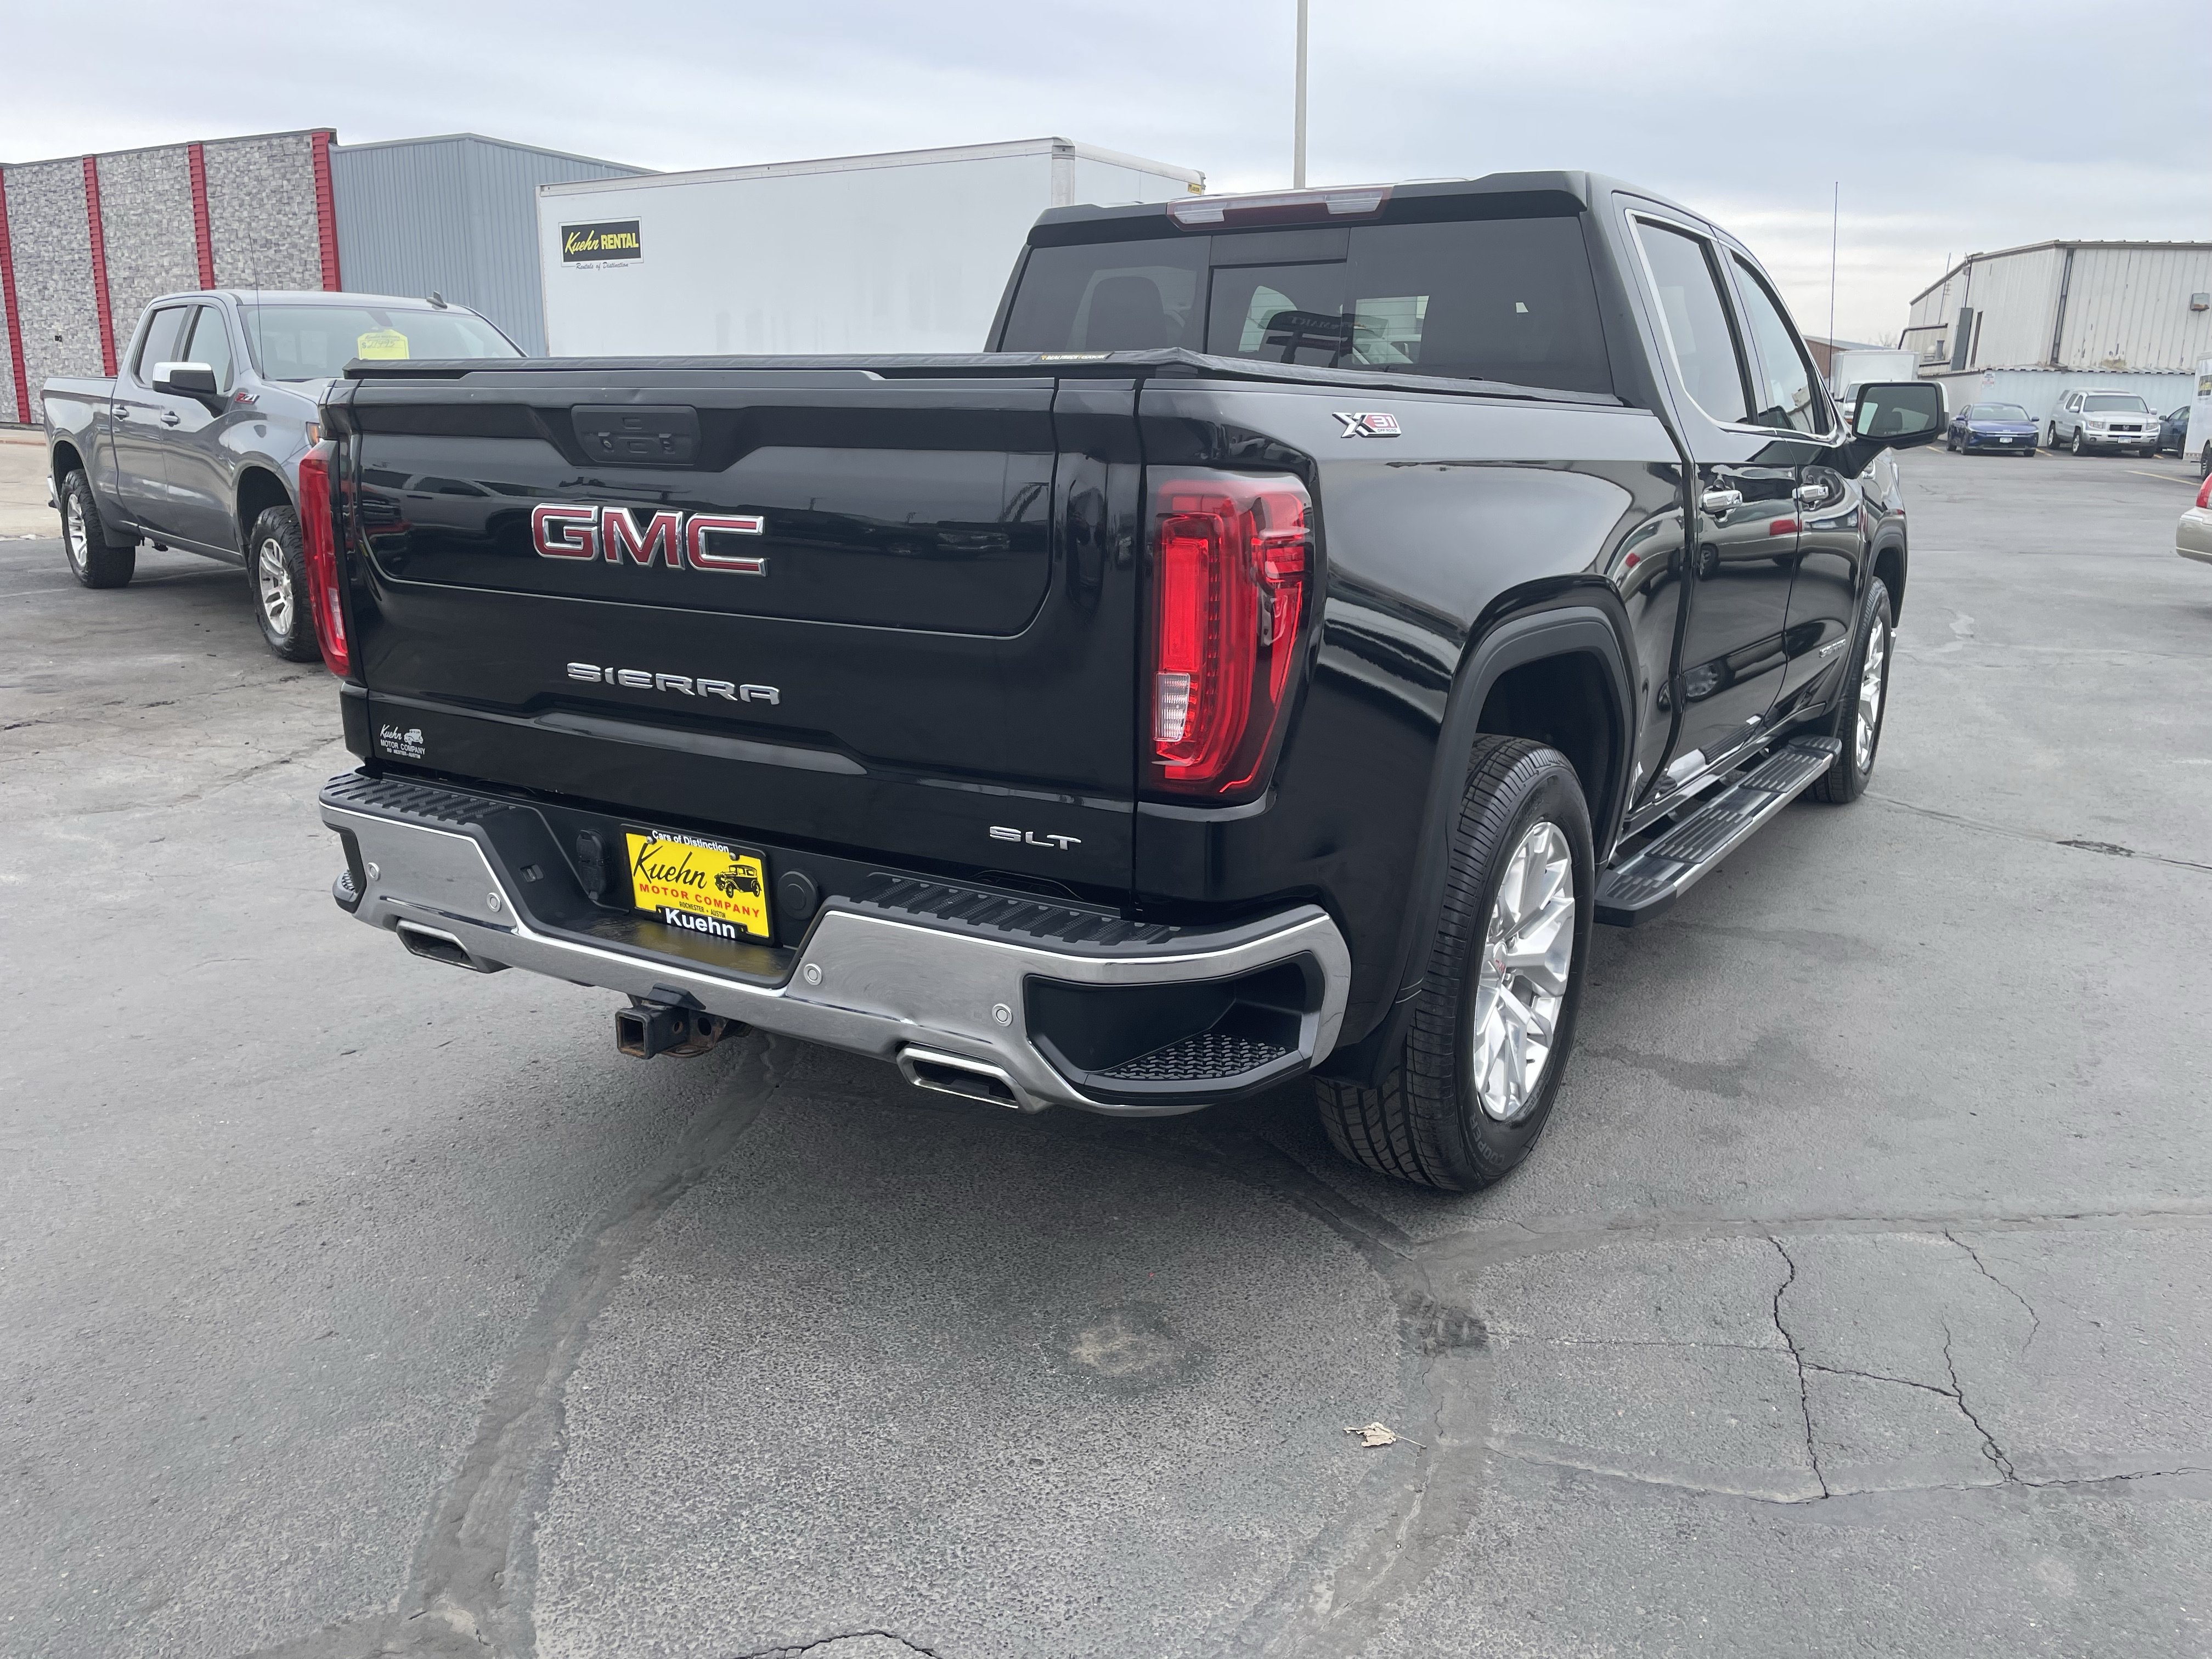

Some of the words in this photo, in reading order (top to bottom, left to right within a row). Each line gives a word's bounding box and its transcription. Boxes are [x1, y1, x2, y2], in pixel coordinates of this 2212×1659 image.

[565, 230, 600, 255] Kuehn
[601, 233, 639, 250] RENTAL
[531, 503, 766, 577] GMC
[567, 662, 781, 705] SIERRA
[380, 724, 402, 740] Kuehn
[380, 739, 399, 749] MOTOR
[400, 743, 426, 755] COMPANY
[652, 830, 672, 842] Cars
[673, 835, 682, 844] of
[684, 836, 729, 853] Distinction
[990, 826, 1081, 850] SLT
[633, 843, 707, 889] Kuehn
[639, 883, 689, 900] MOTOR
[695, 894, 760, 918] COMPANY
[679, 901, 704, 913] ROCHESTER
[710, 908, 726, 919] AUSTIN
[665, 908, 735, 939] Kuehn
